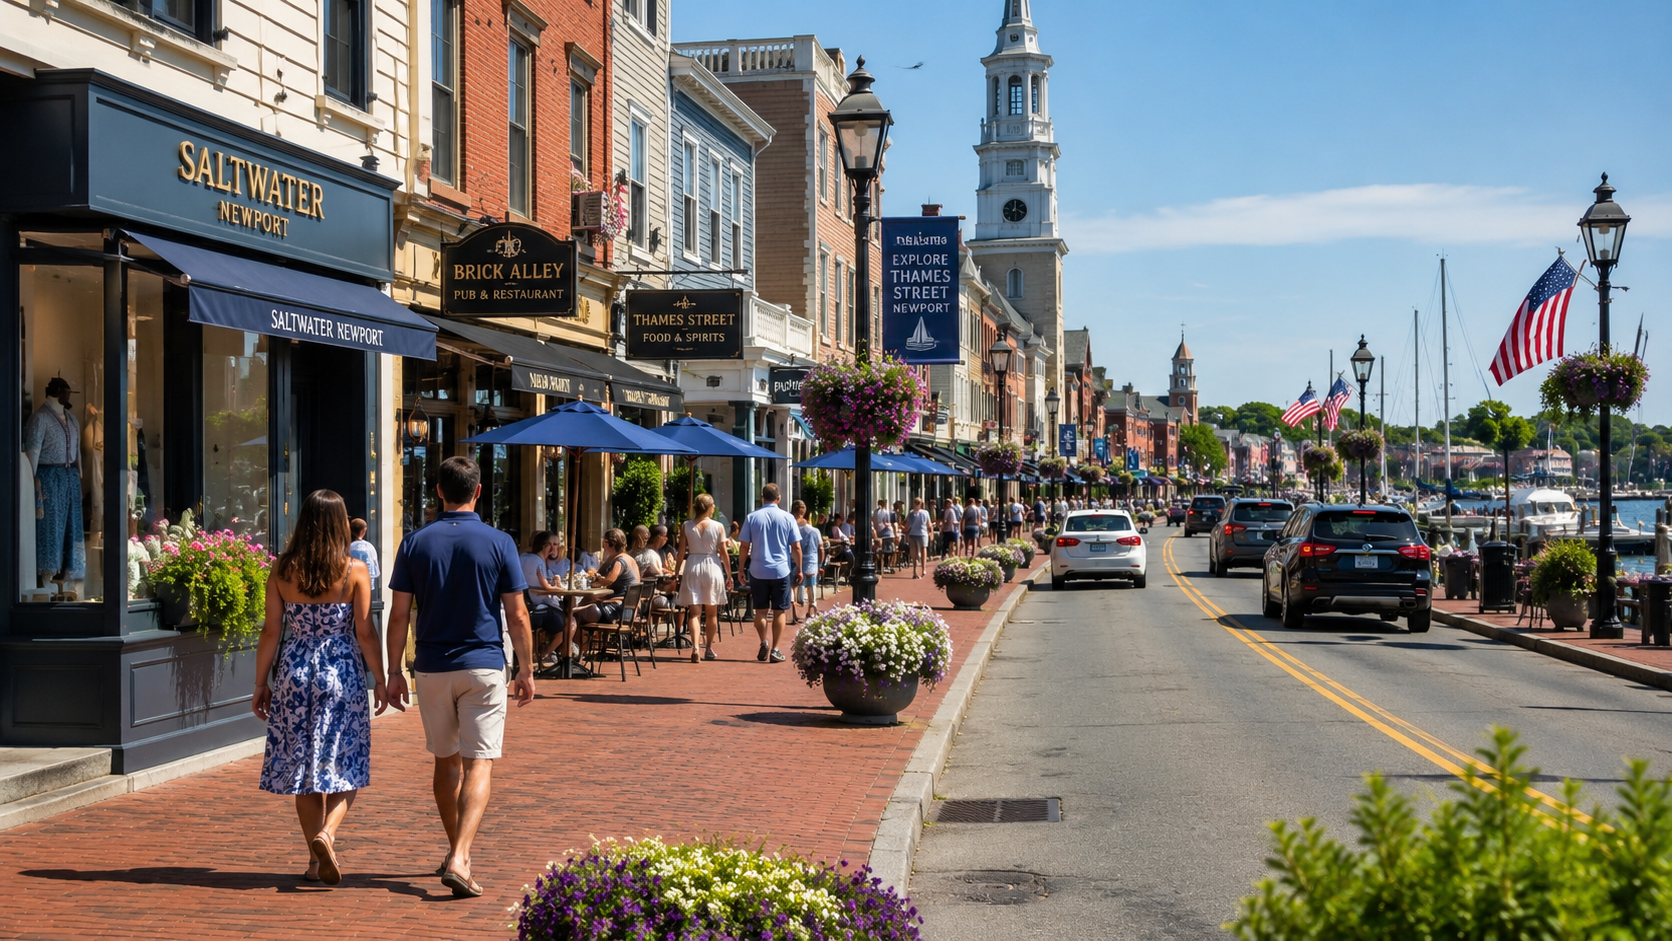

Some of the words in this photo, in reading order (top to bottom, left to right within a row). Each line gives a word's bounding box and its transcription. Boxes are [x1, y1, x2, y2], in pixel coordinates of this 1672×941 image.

[178, 140, 326, 220] SALTWATER
[218, 199, 290, 237] NEWPORT
[892, 253, 949, 266] EXPLORE
[453, 263, 504, 280] BRICK
[509, 262, 564, 279] ALLEY
[889, 269, 951, 283] THAMES
[453, 289, 477, 300] PUB
[480, 289, 489, 300] &
[493, 289, 565, 300] RESTAURANT
[893, 285, 950, 300] STREET
[892, 302, 951, 314] NEWPORT
[271, 309, 334, 339] SALTWATER
[633, 313, 684, 326] THAMES
[687, 313, 736, 326] STREET
[643, 332, 672, 343] FOOD
[685, 332, 726, 343] SPIRITS
